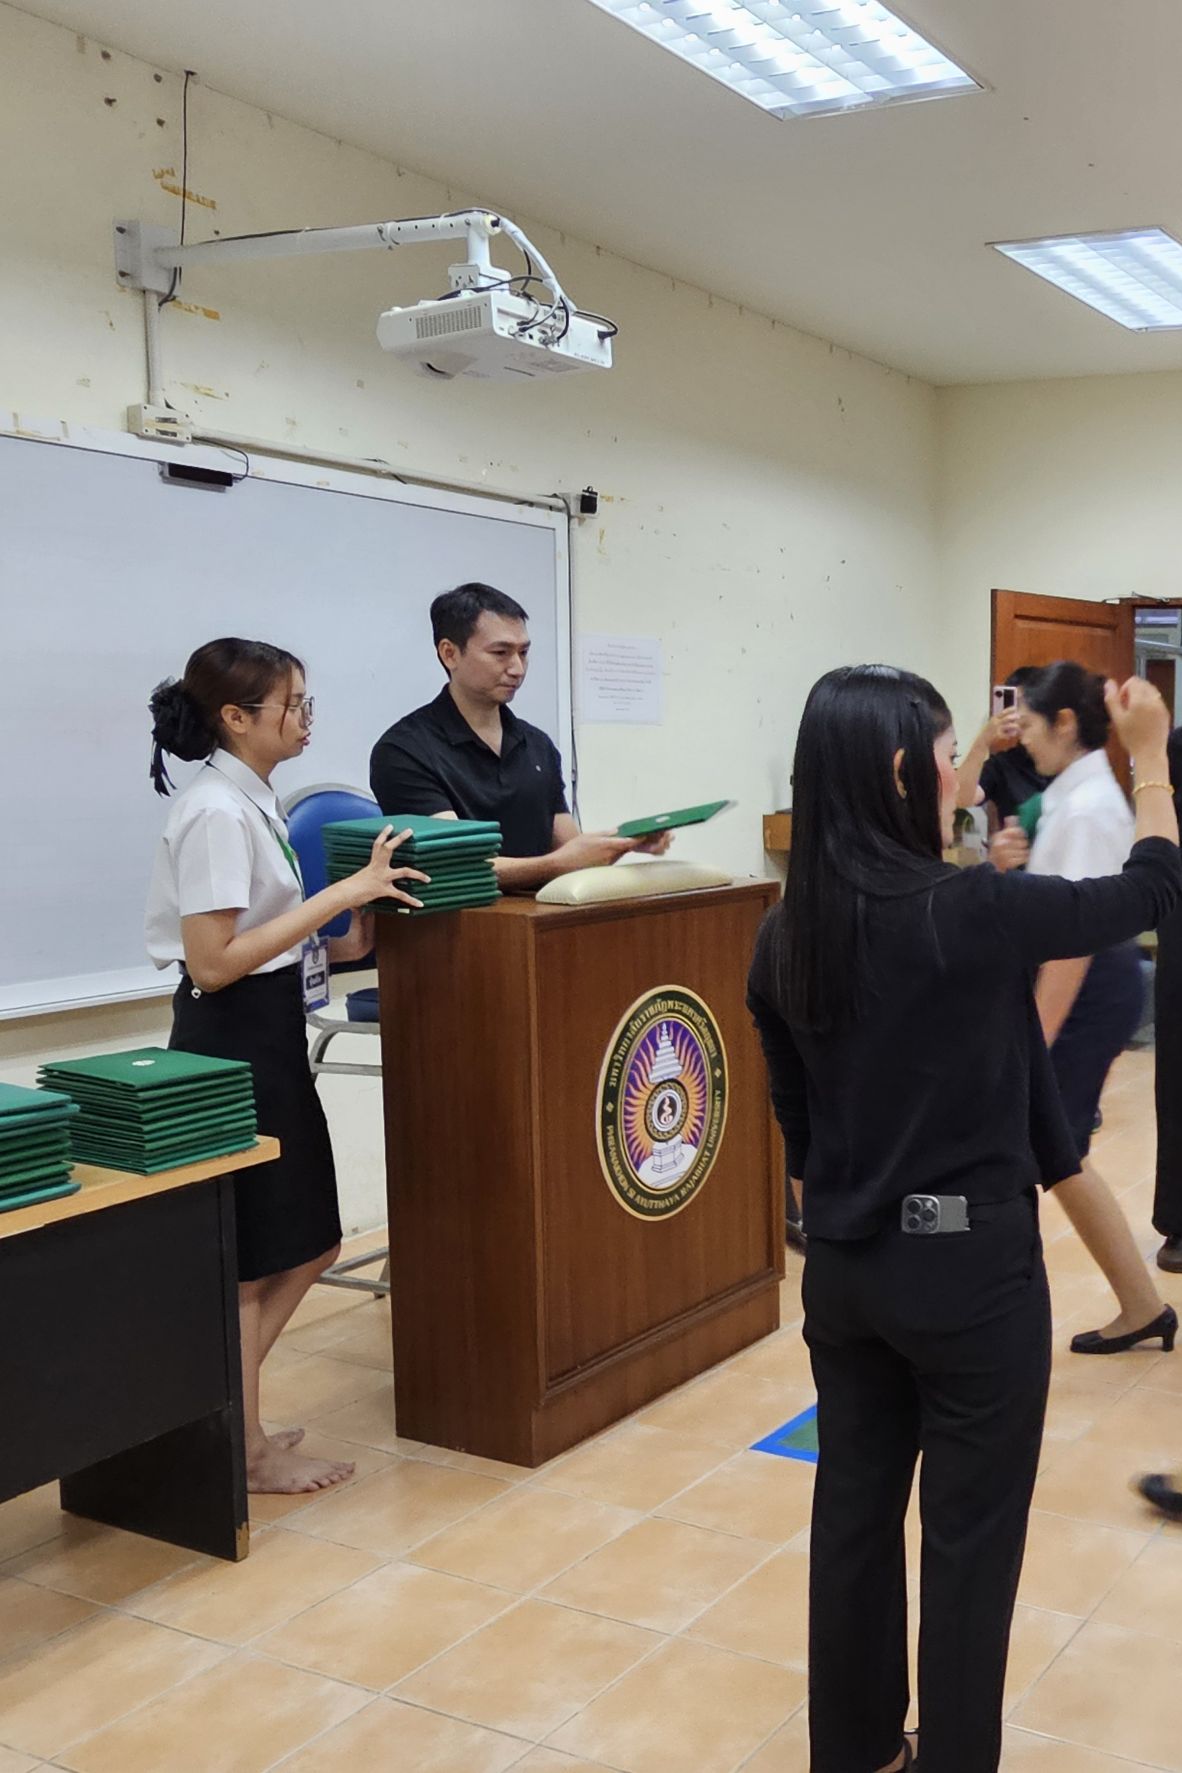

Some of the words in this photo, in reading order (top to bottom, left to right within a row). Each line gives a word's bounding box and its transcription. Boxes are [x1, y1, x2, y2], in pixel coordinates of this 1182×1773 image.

[606, 1125, 632, 1192] PHRANAKHON
[626, 1189, 637, 1199] SI
[634, 1194, 680, 1209] AYUTTHAYA
[680, 1150, 711, 1197] RAJABHAT
[706, 1089, 722, 1148] UNIVERSITY
